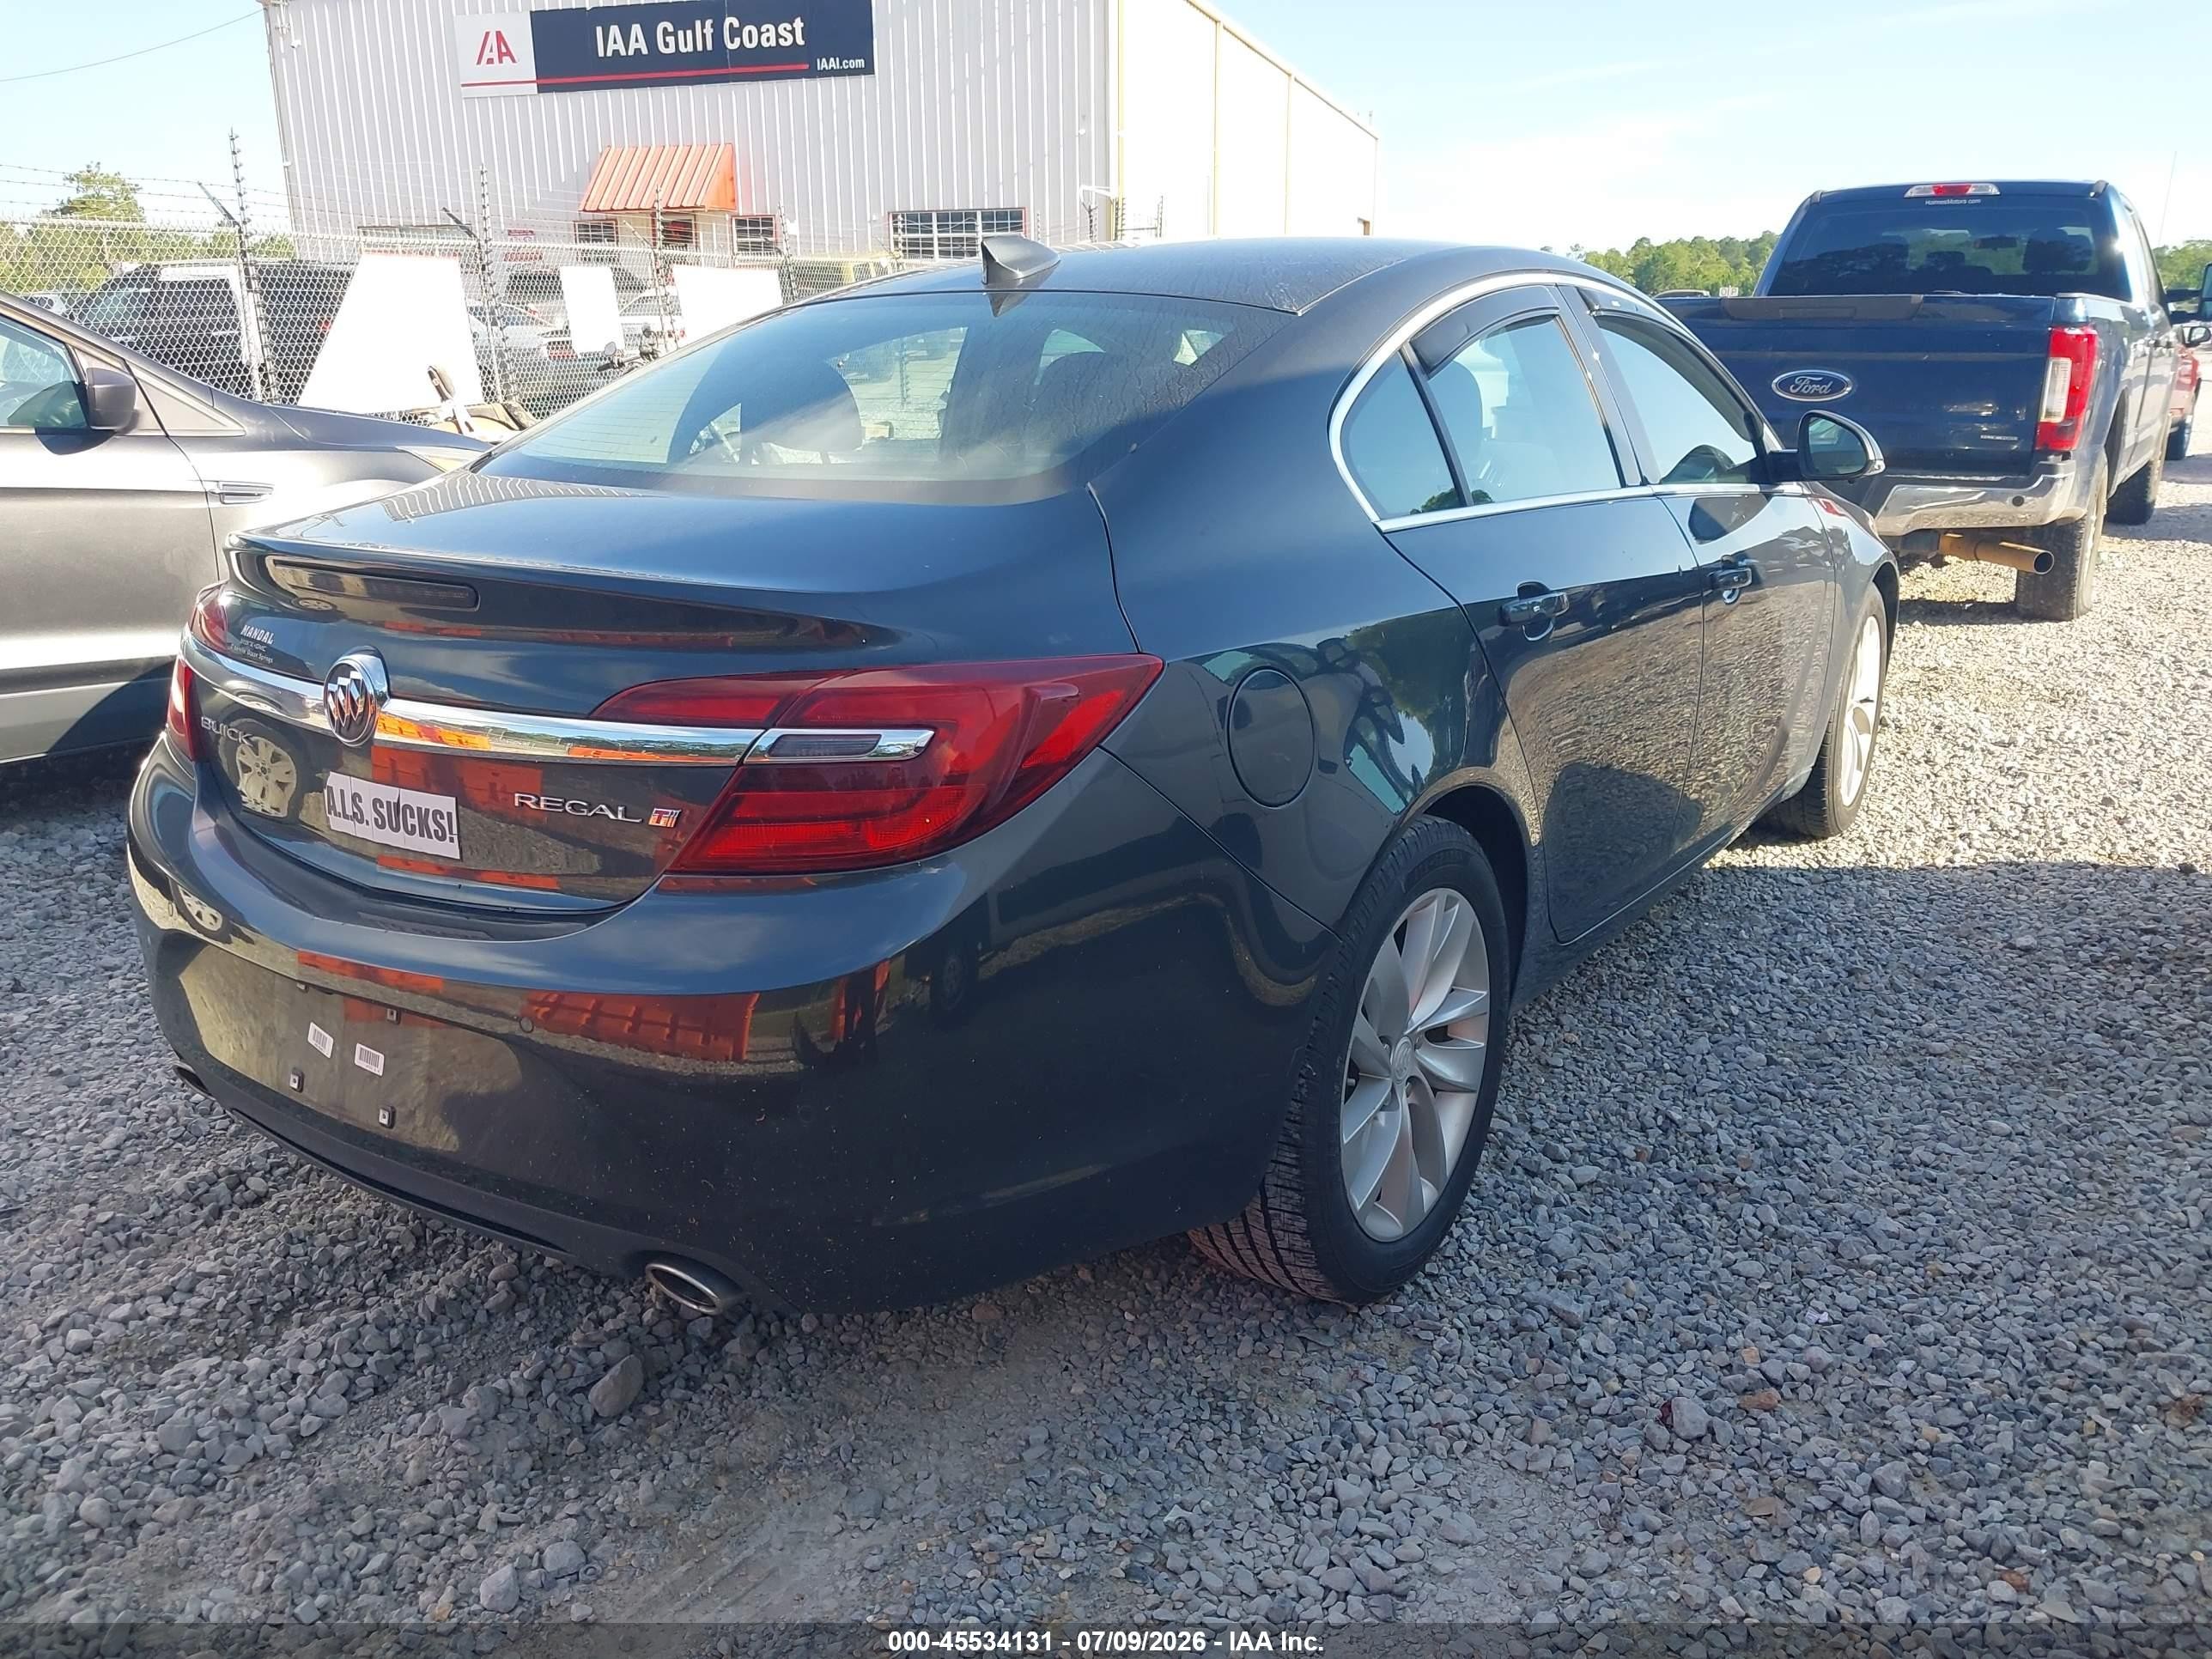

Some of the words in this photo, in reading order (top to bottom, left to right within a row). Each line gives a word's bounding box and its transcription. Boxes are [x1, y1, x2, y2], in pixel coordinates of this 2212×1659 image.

[596, 24, 648, 58] IAA
[657, 19, 714, 54] Gulf
[723, 16, 805, 50] Coast
[817, 58, 866, 71] IAAI.com
[1790, 376, 1833, 394] Ford
[240, 624, 275, 645] MANDAL
[201, 717, 253, 746] BUICK
[372, 797, 454, 843] SUCKS!
[514, 793, 643, 823] REGAL
